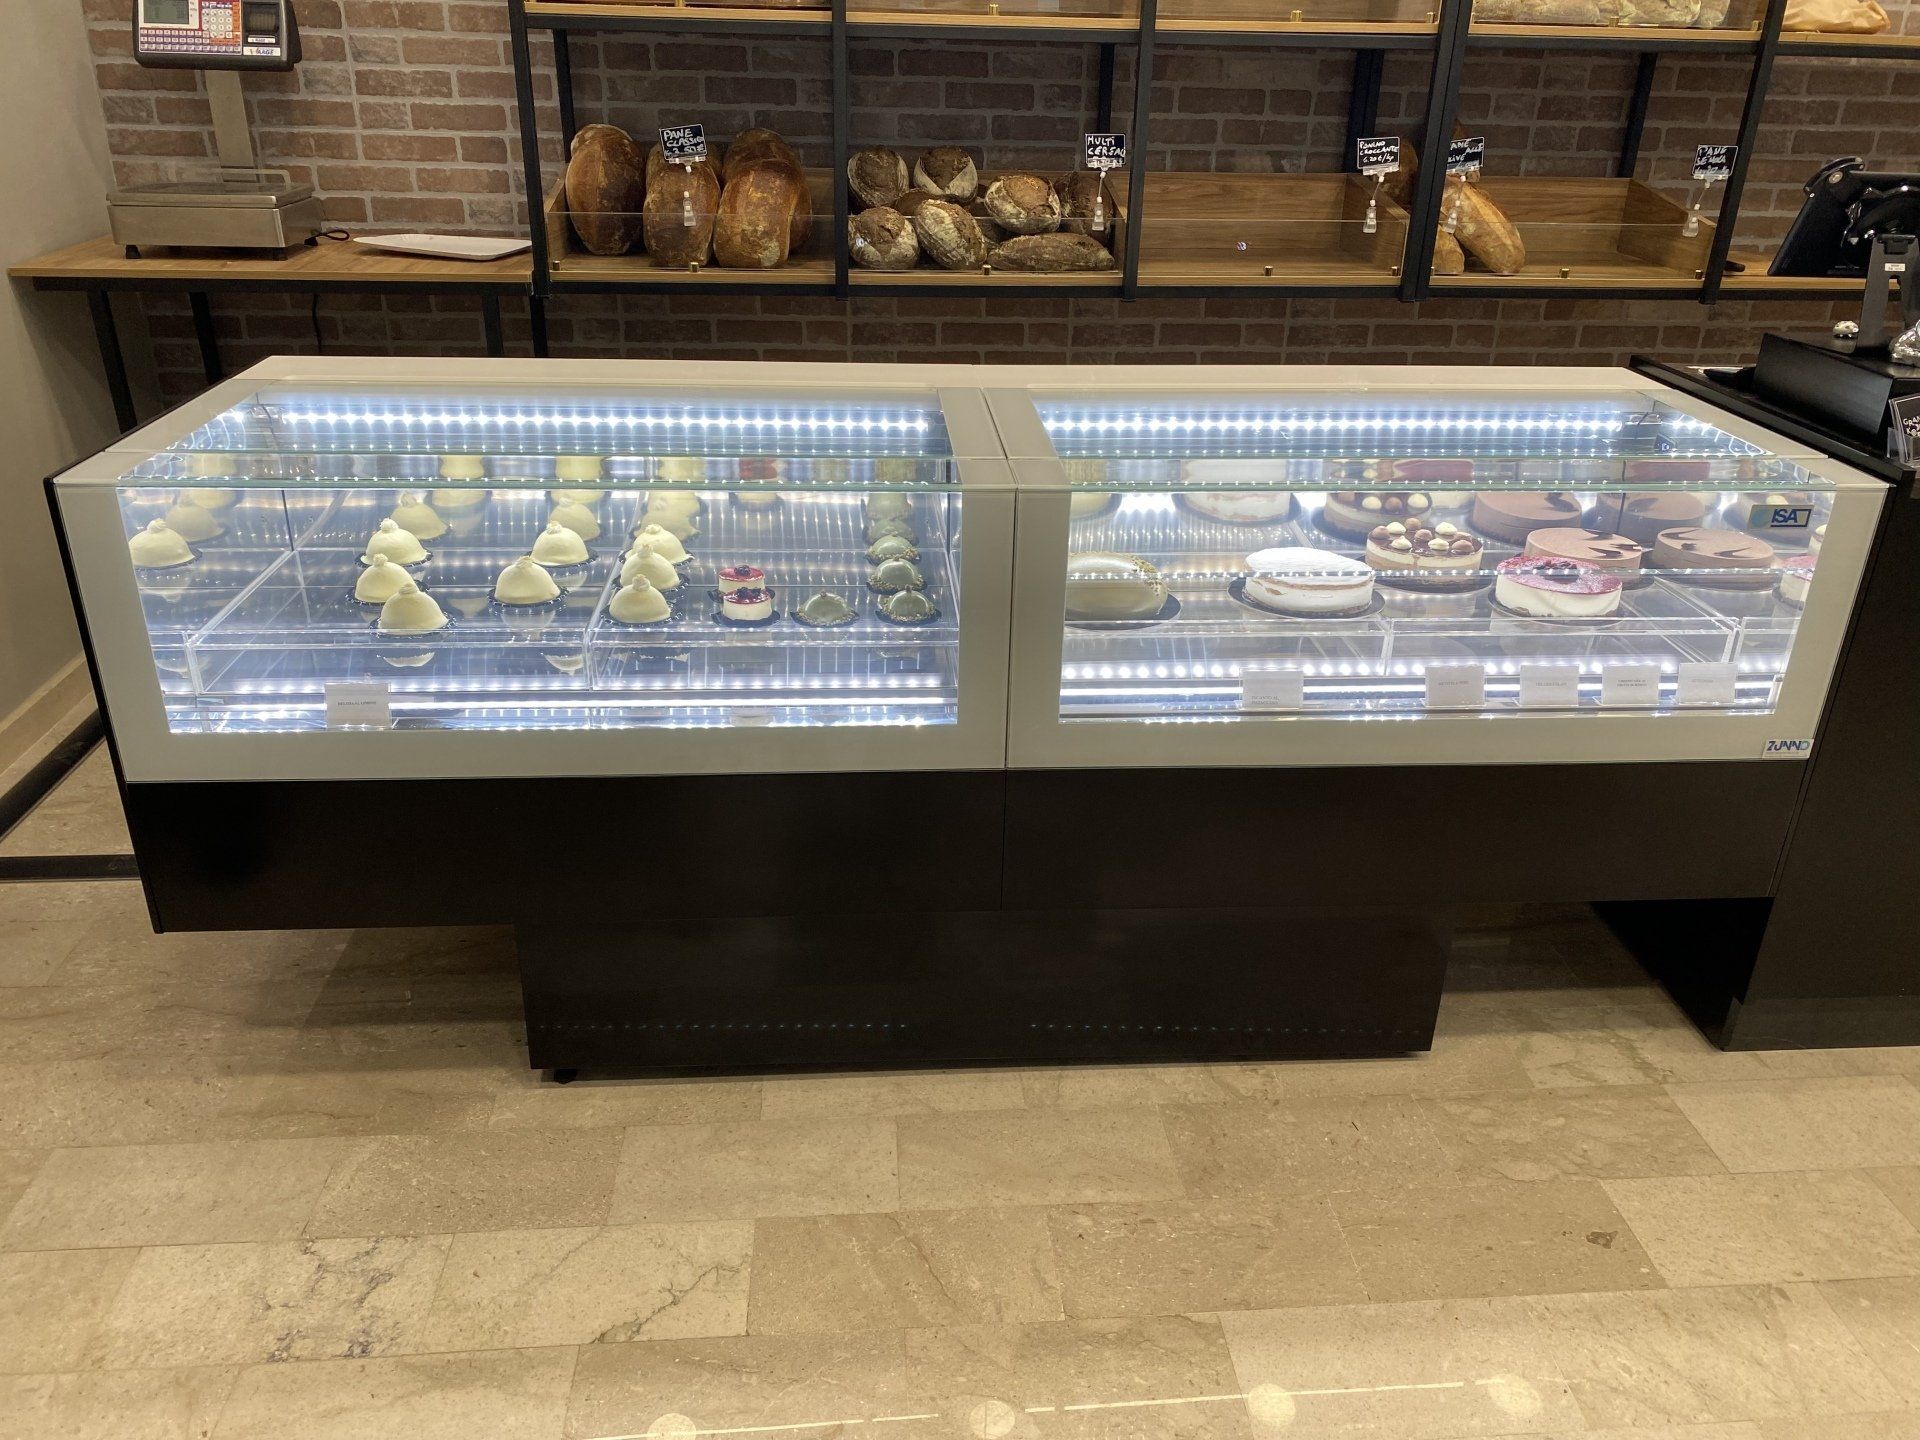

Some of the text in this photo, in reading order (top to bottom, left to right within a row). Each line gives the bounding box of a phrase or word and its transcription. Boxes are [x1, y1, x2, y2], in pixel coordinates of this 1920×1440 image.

[664, 128, 693, 142] PANE
[1450, 139, 1470, 150] ANE
[1771, 508, 1799, 523] ISA
